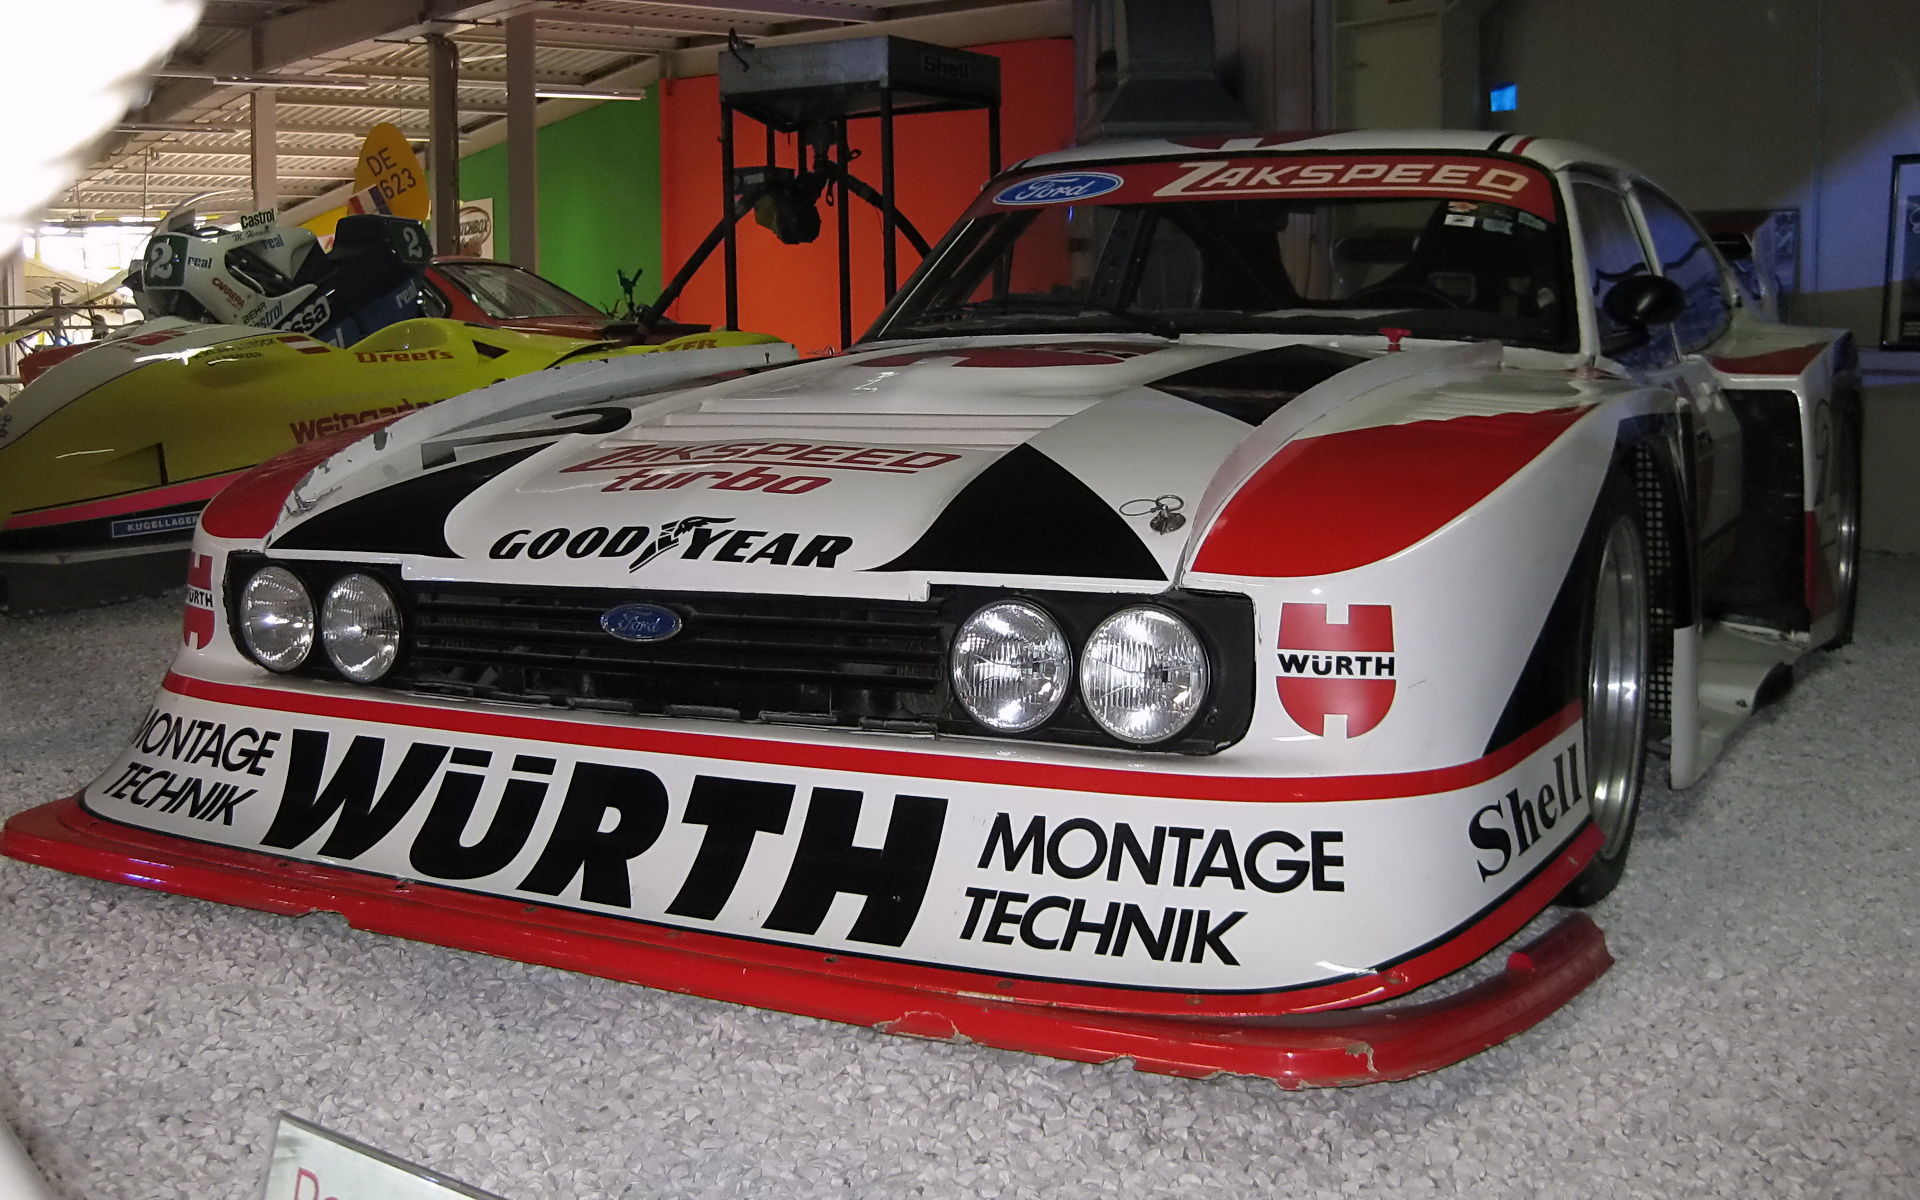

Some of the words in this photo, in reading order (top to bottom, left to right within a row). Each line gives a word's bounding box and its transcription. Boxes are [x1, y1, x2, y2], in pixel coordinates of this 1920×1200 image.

[923, 55, 969, 80] Shell
[366, 147, 397, 176] DE
[380, 168, 416, 200] 623
[1153, 161, 1530, 199] ZAKSPEED
[240, 208, 275, 229] Castrol
[263, 234, 285, 249] real
[403, 227, 423, 258] 2
[151, 241, 173, 279] 2
[188, 256, 212, 269] real
[212, 277, 246, 308] CARRERA
[354, 350, 454, 363] Dreefs
[559, 442, 962, 475] ZAKSPEED
[600, 466, 832, 495] turbo
[1277, 653, 1395, 677] WÜRTH
[103, 761, 259, 827] TECHNIK
[1467, 743, 1584, 883] Shell
[259, 728, 950, 948] WÜRTH
[977, 811, 1346, 894] MONTAGE
[959, 887, 1249, 967] TECHNIK
